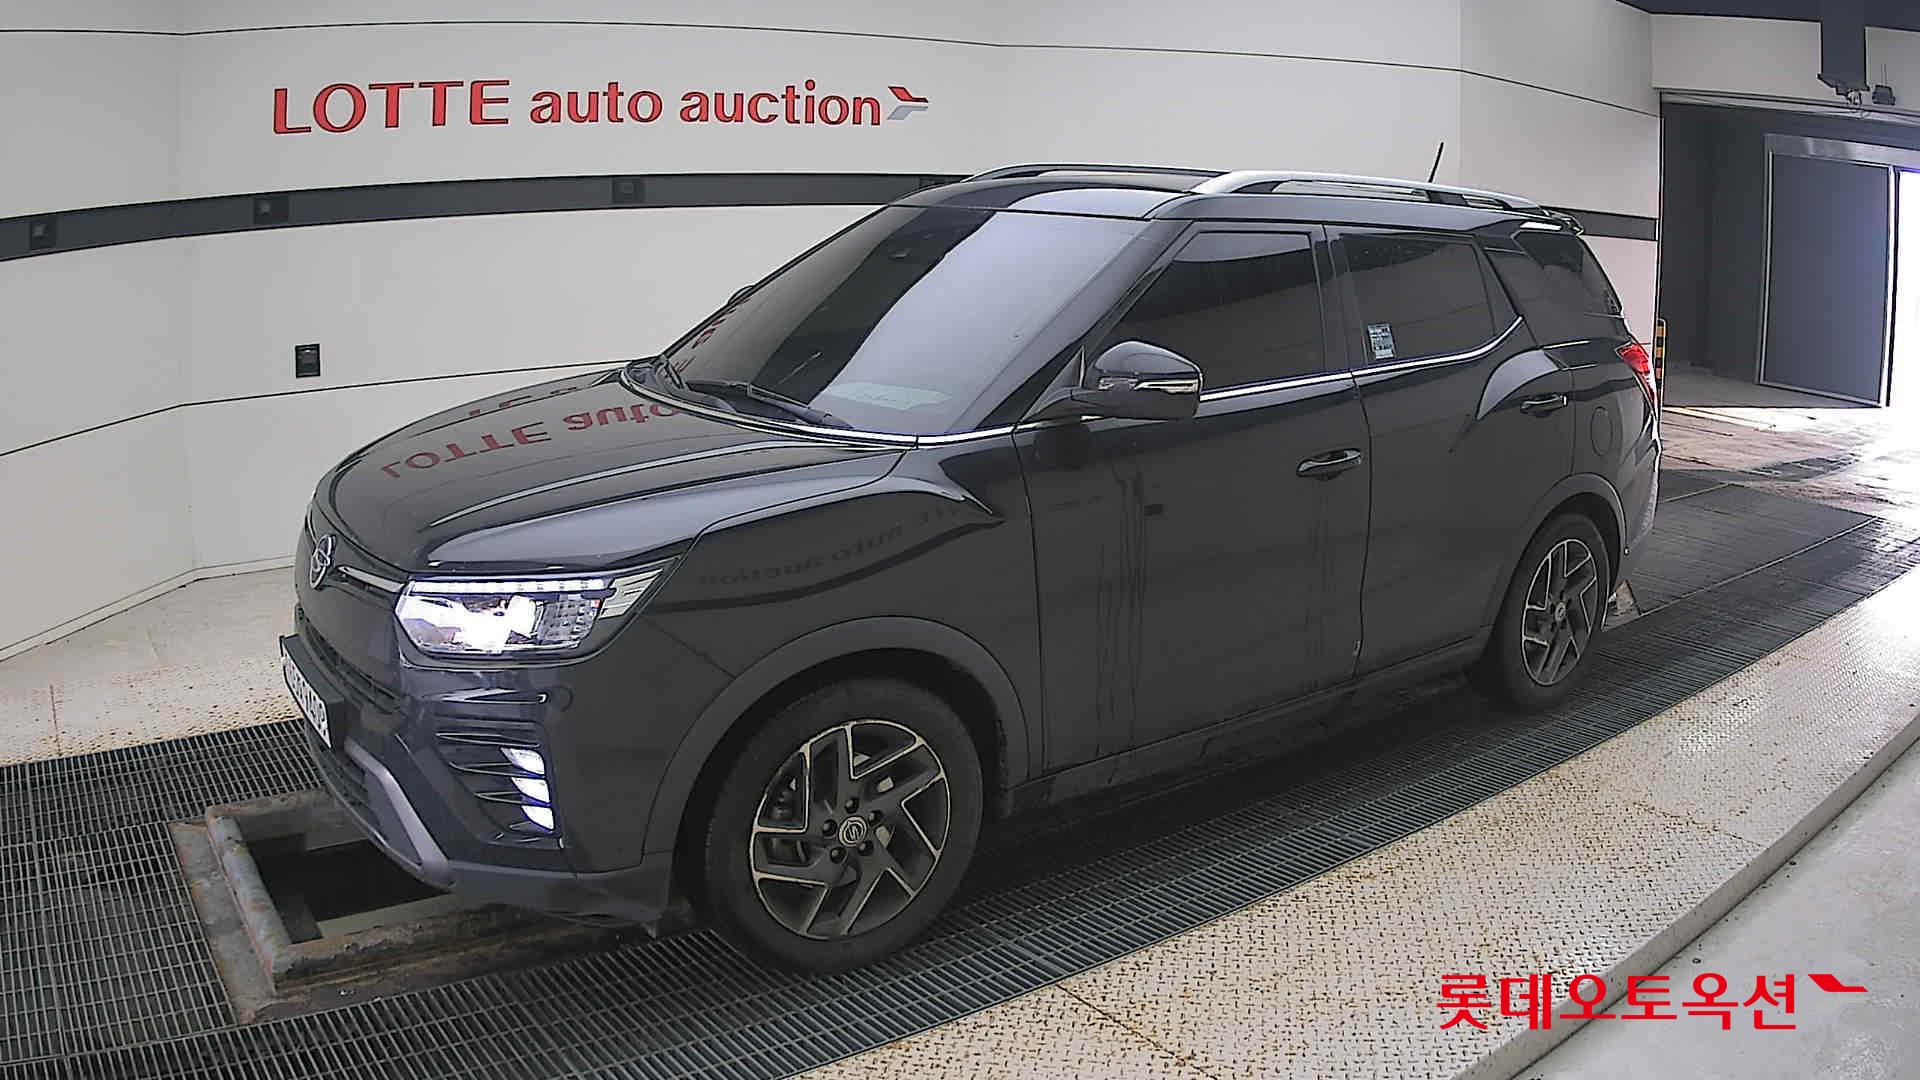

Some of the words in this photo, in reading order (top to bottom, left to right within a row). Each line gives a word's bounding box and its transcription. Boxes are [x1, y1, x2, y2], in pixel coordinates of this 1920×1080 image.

[273, 79, 510, 135] LOTTE
[530, 81, 663, 124] auto
[679, 79, 882, 126] auction
